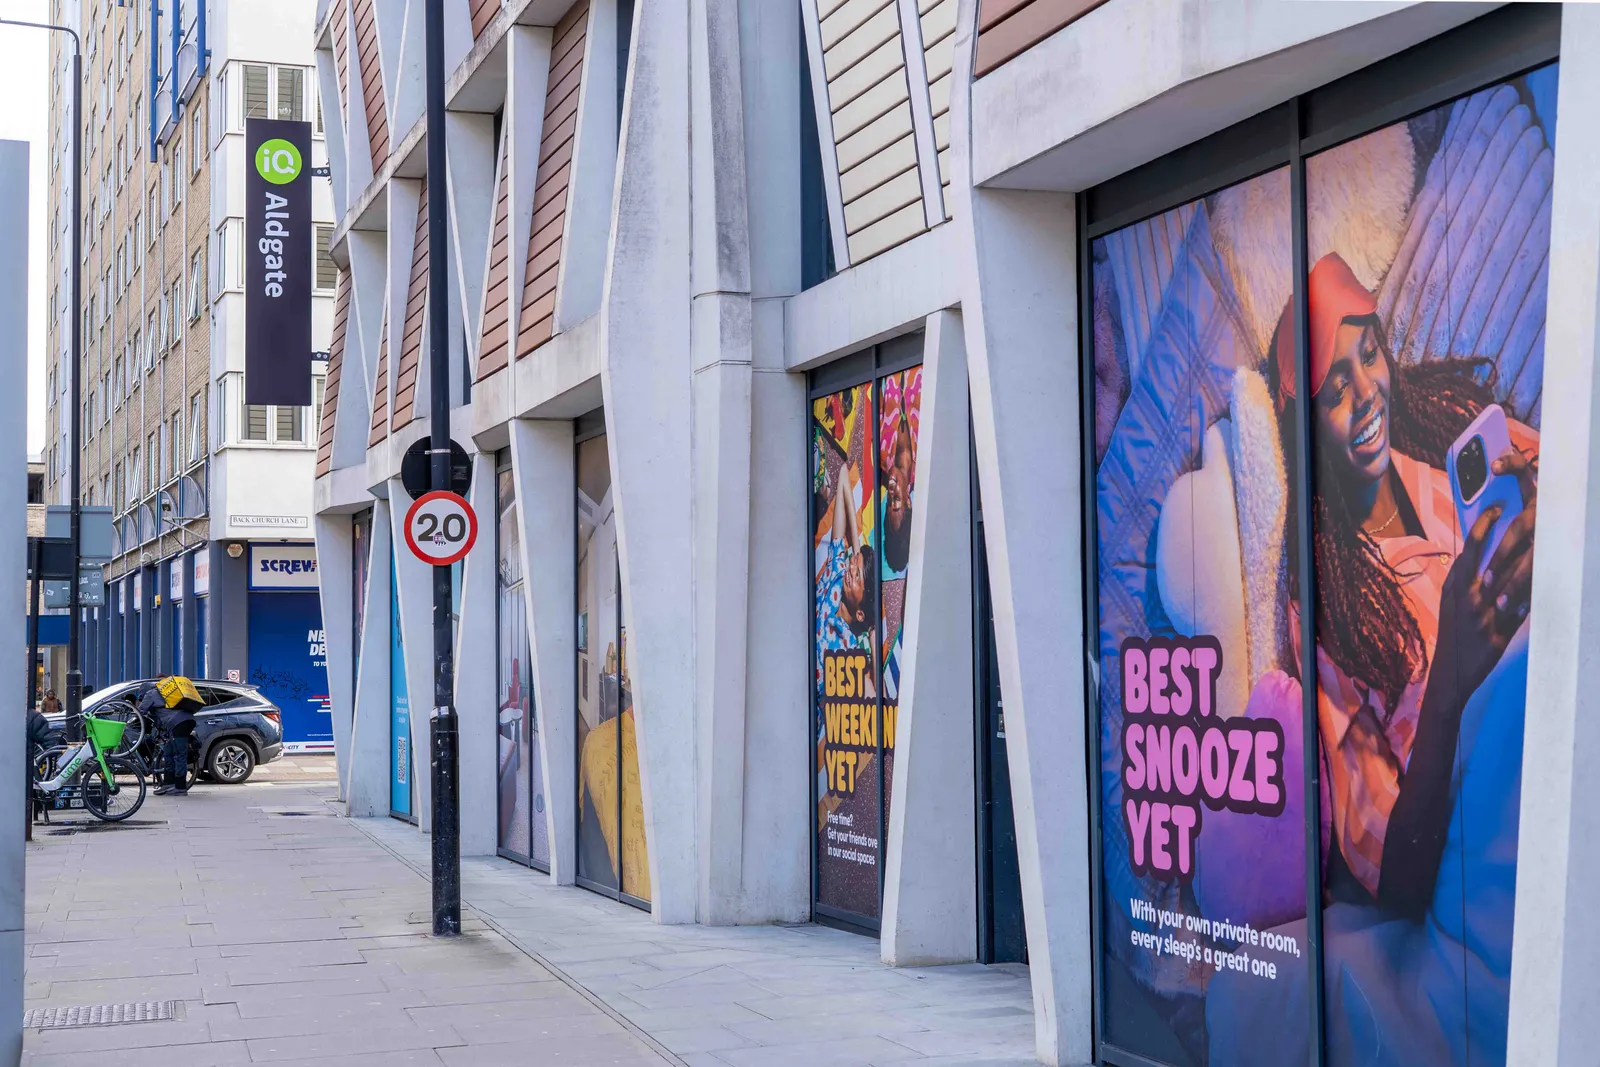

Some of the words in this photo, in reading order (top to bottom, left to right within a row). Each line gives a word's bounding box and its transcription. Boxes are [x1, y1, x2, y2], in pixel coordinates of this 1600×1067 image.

[263, 148, 296, 174] iQ
[259, 192, 289, 298] Aldgate
[417, 513, 466, 542] 20
[825, 655, 866, 698] BEST
[1125, 647, 1217, 717] BEST
[61, 757, 82, 779] Lime
[826, 749, 857, 793] YET
[1125, 723, 1280, 804] SNOOZE
[827, 826, 837, 840] Get
[837, 831, 849, 844] your
[849, 830, 867, 847] friends
[868, 837, 878, 848] ove
[828, 810, 839, 824] Free
[839, 812, 854, 827] time?
[1126, 798, 1196, 874] YET
[827, 843, 833, 856] in
[833, 847, 842, 858] our
[842, 848, 857, 861] social
[857, 852, 876, 865] spaces
[1130, 898, 1156, 923] With
[1157, 908, 1184, 930] your
[1186, 915, 1211, 935] own
[1212, 918, 1259, 946] private
[1260, 931, 1301, 957] room,
[1131, 930, 1162, 956] every
[1164, 934, 1201, 964] sleep's
[1203, 947, 1212, 964] a
[1214, 949, 1250, 972] great
[1251, 958, 1277, 980] one
